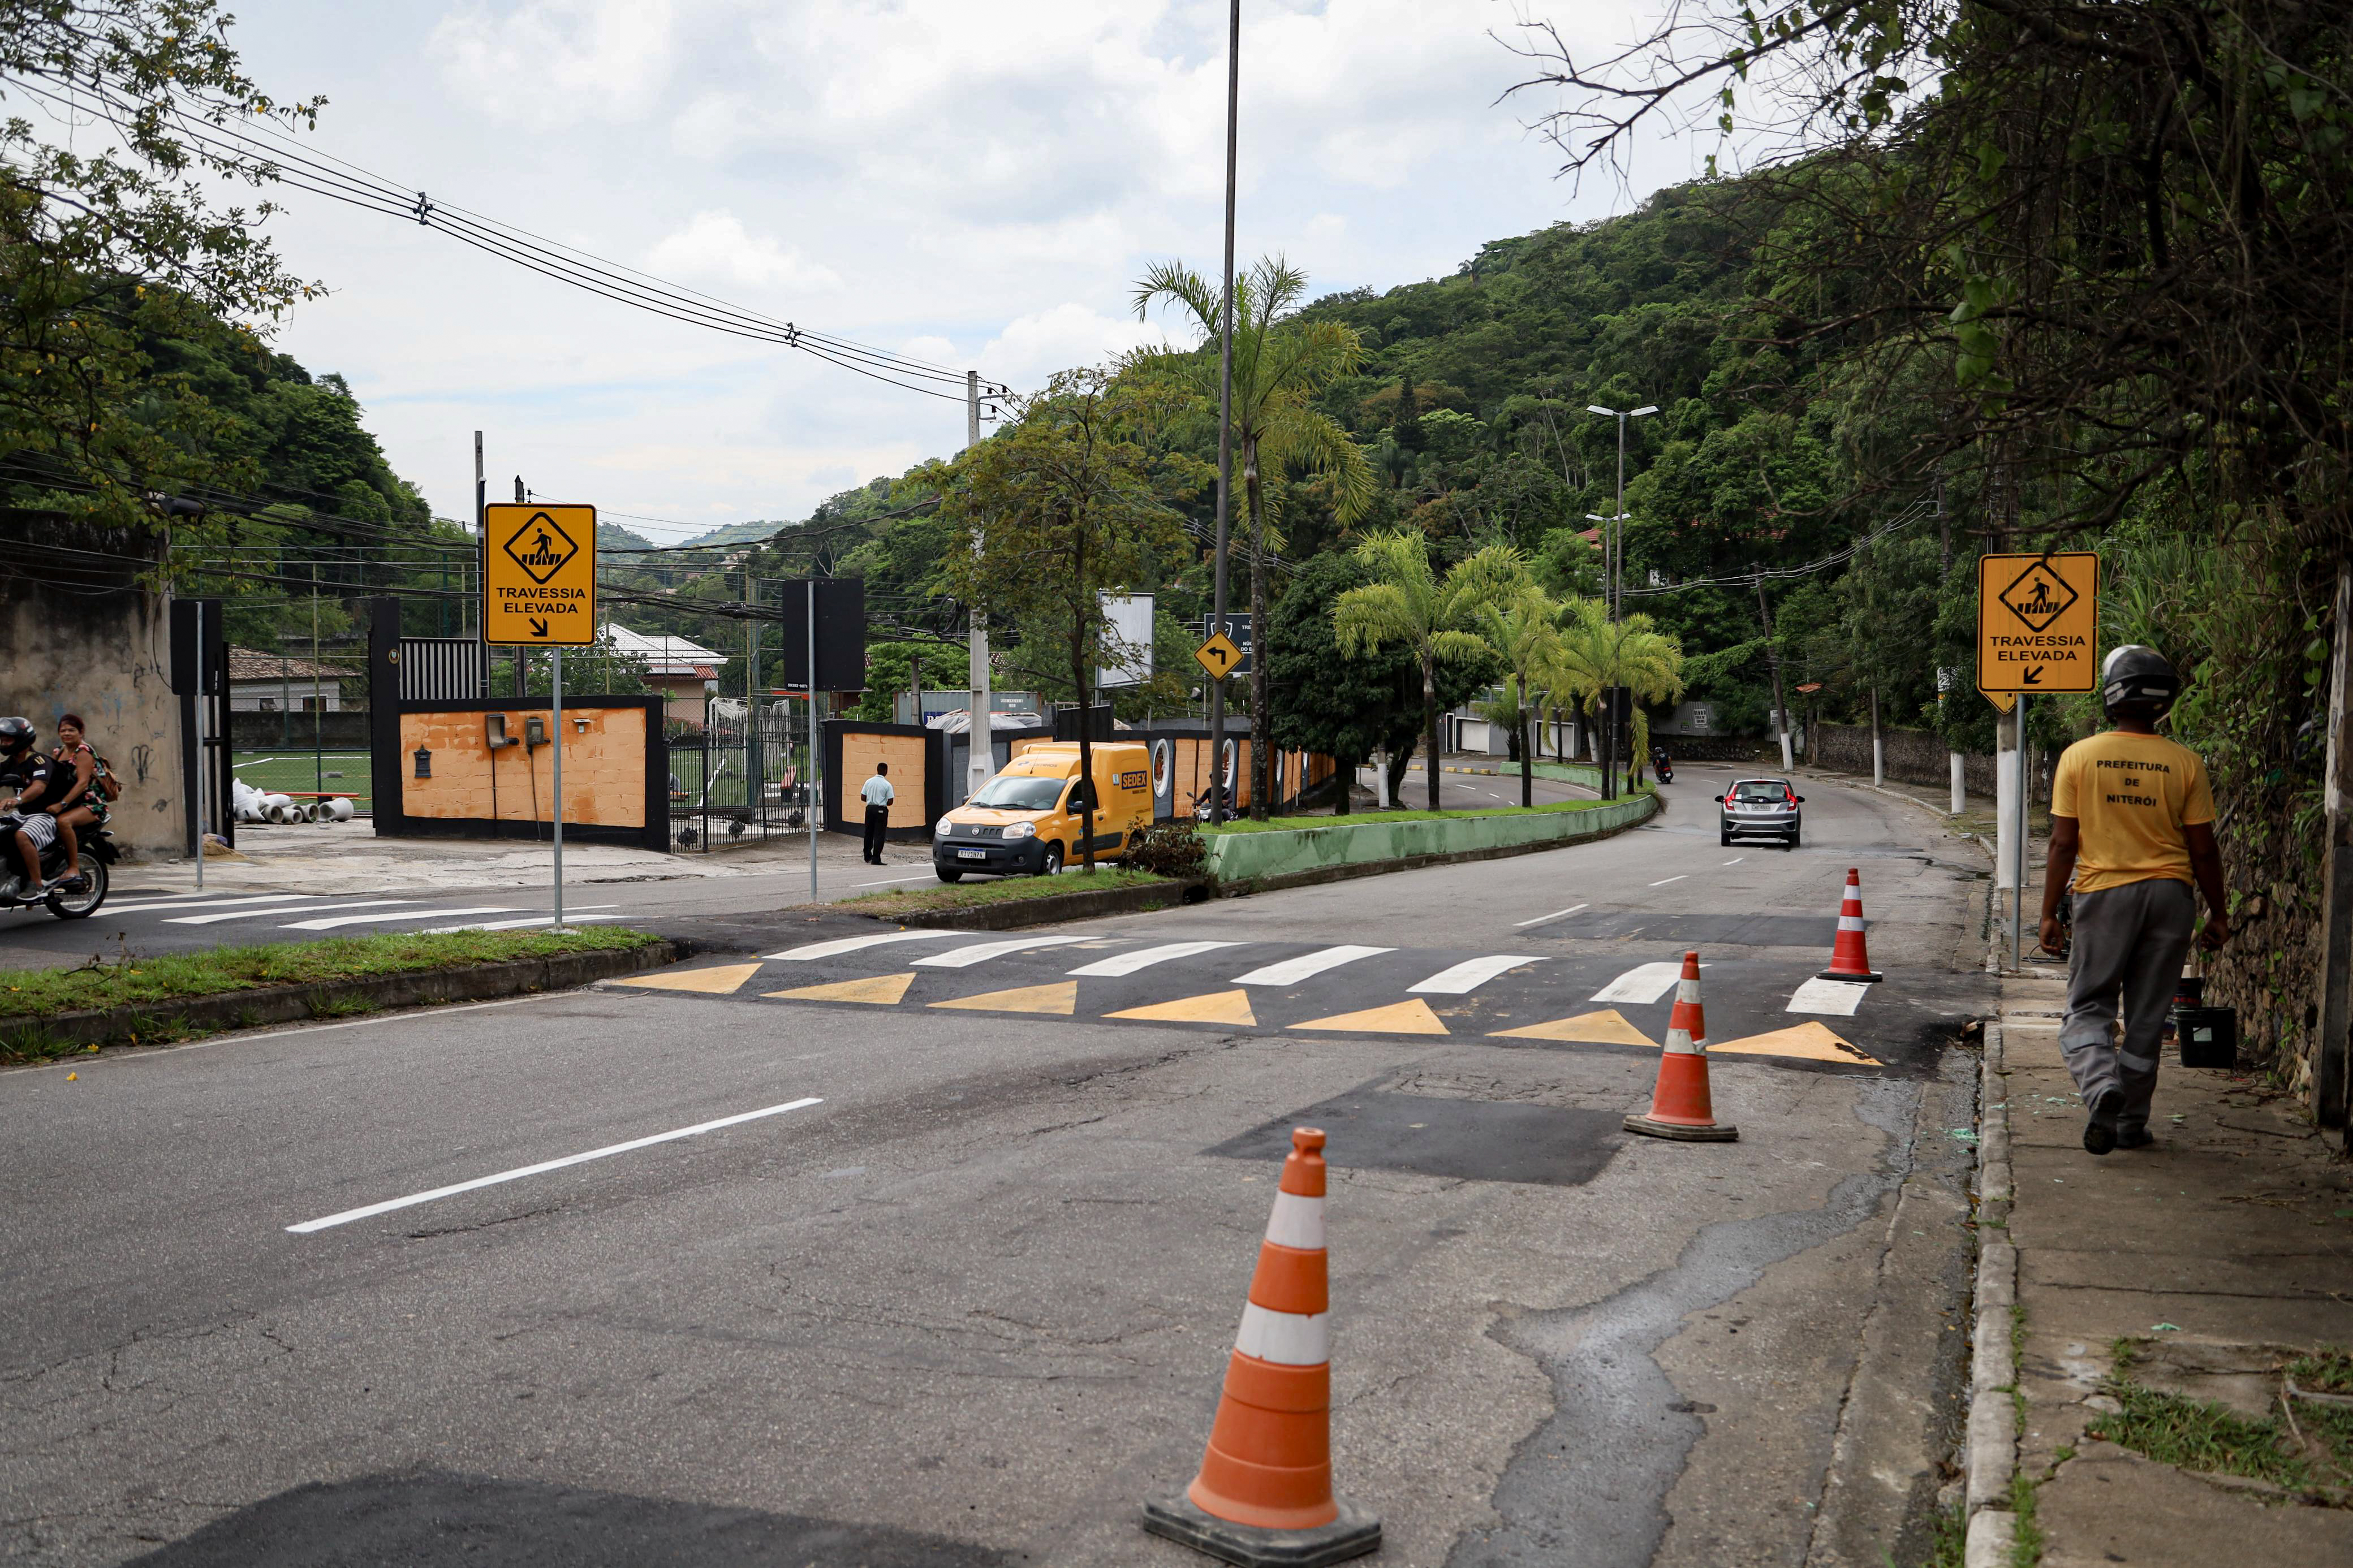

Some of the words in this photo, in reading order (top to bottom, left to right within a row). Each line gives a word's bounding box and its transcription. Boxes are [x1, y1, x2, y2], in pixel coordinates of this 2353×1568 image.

[496, 588, 586, 599] TRAVESSIA
[504, 602, 579, 614] ELEVADA
[1990, 636, 2086, 646] TRAVESSIA
[1998, 650, 2078, 661] ELEVADA
[2096, 759, 2170, 774] PREFEITURA
[1122, 772, 1147, 788] SEDEX
[2124, 777, 2140, 787] DE
[2106, 794, 2157, 807] NITERÓI
